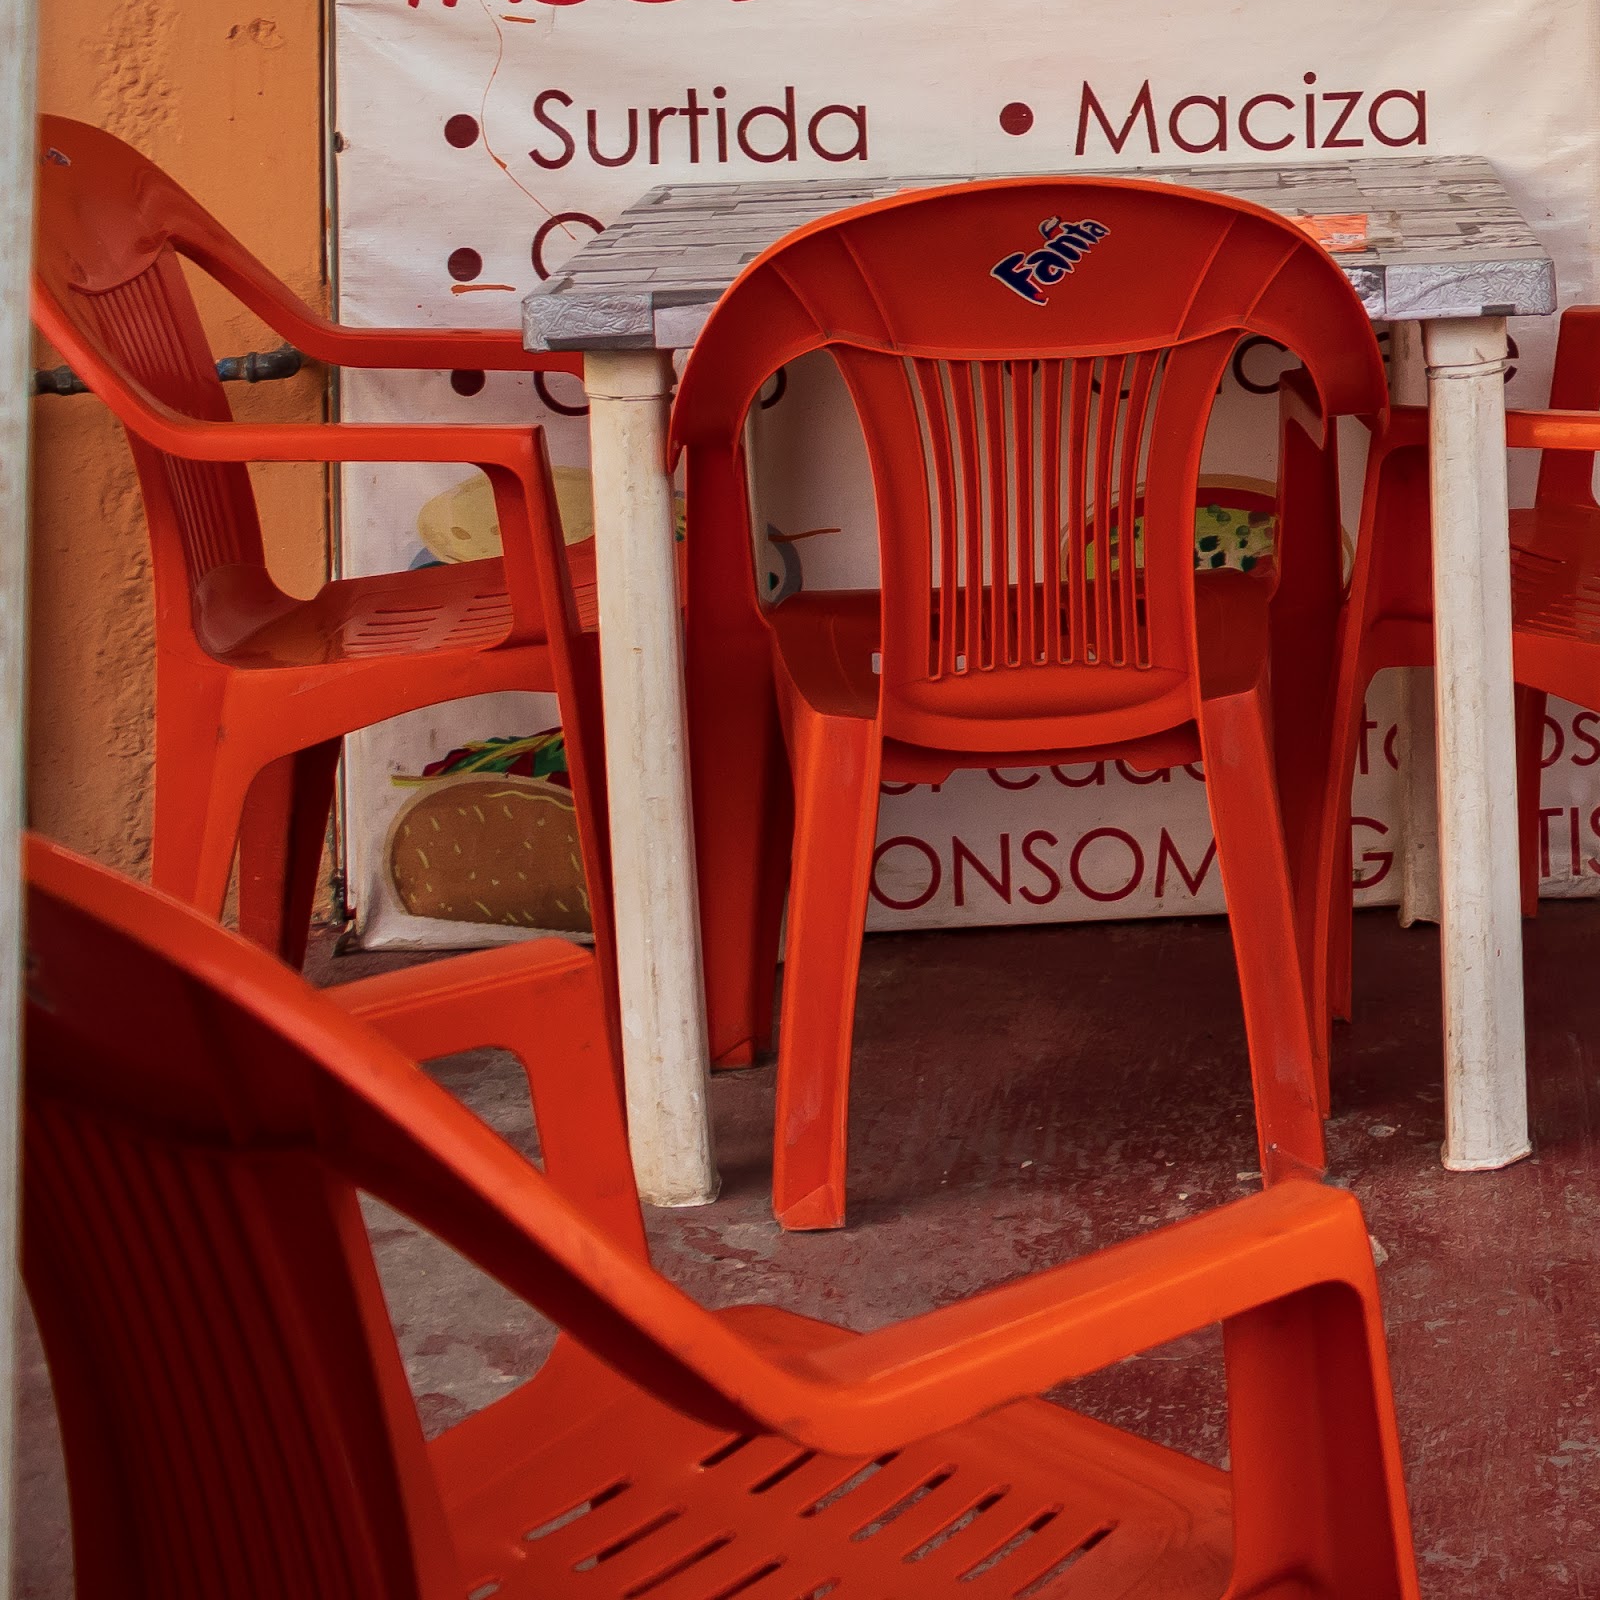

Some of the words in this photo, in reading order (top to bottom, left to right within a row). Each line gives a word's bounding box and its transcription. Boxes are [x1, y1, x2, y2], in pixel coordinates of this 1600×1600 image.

[527, 85, 868, 170] Surtida
[1074, 70, 1429, 156] Maciza
[990, 216, 1112, 306] Fanta
[869, 827, 1216, 912] ONSOM
